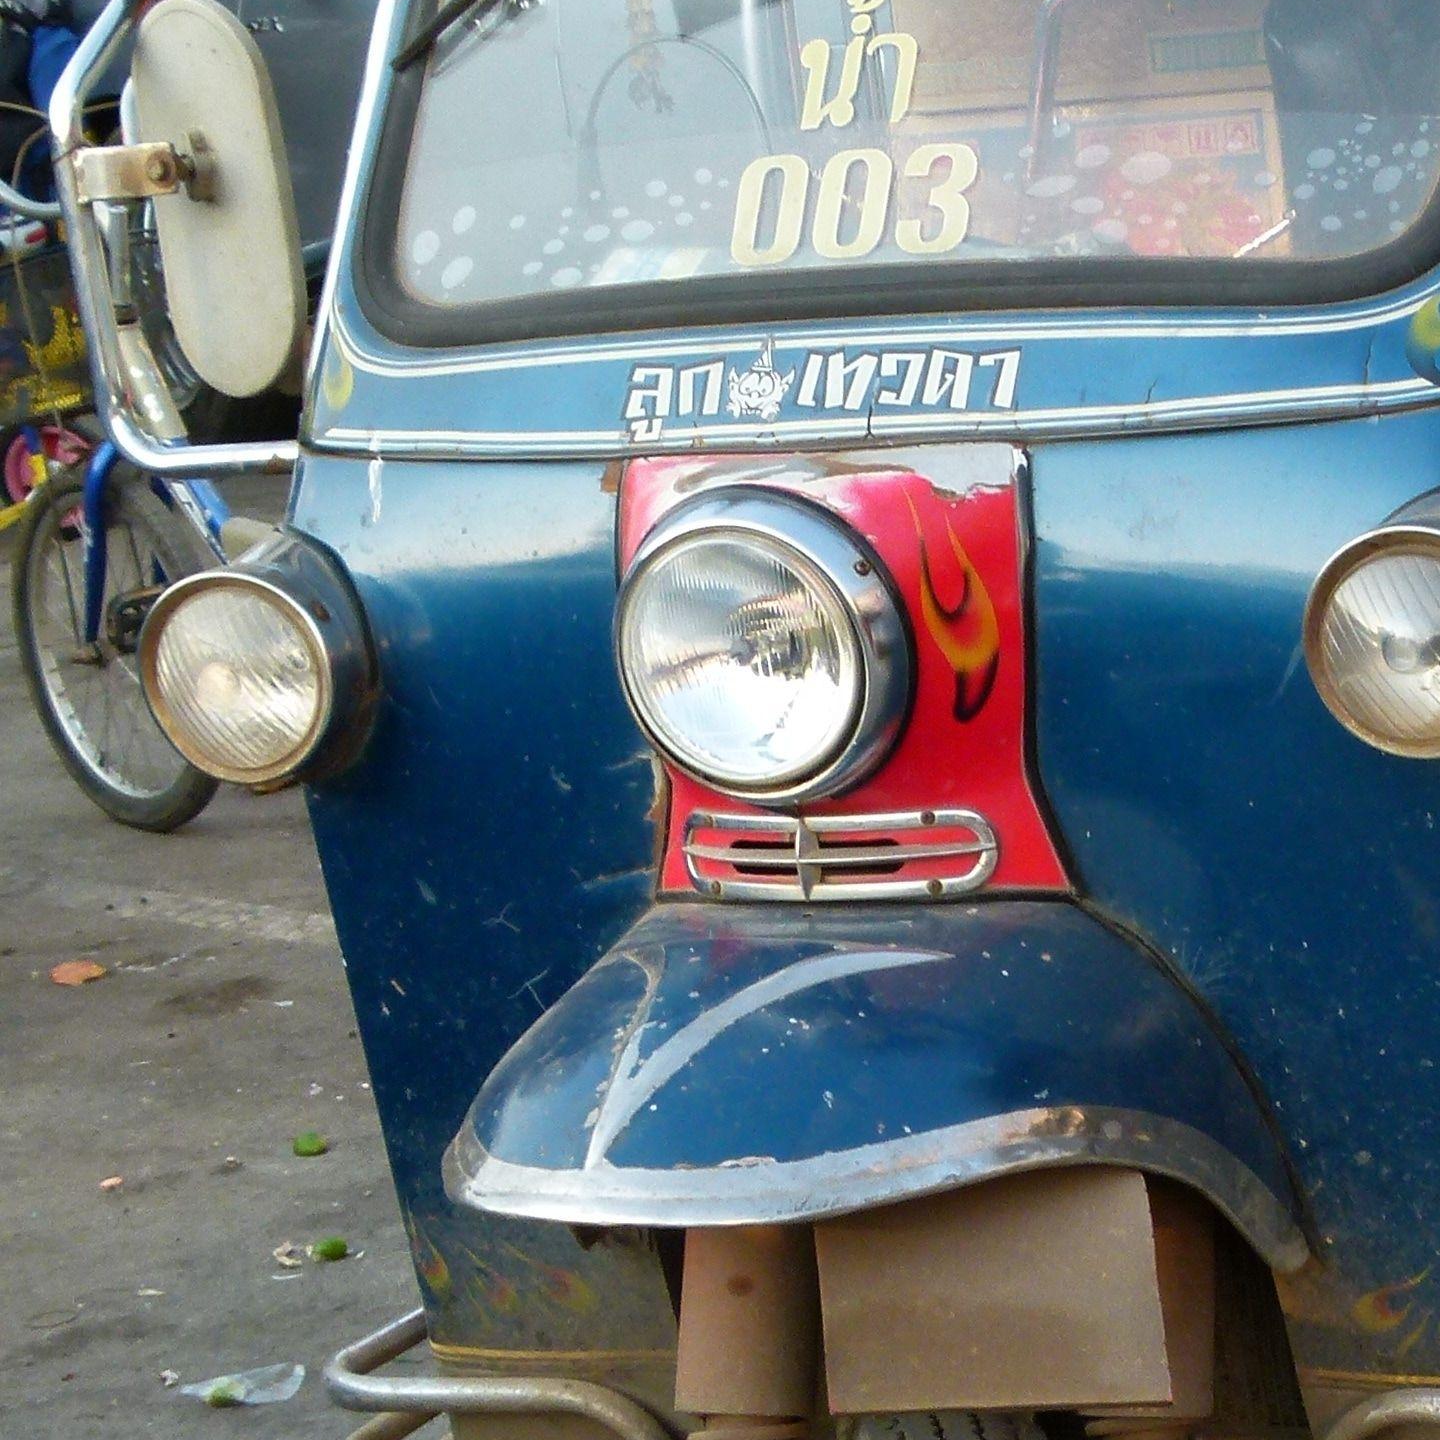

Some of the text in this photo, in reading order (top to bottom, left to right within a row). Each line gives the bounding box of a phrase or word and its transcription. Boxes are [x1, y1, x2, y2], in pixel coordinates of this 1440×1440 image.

[730, 142, 978, 266] 003
[625, 360, 727, 443] ลูก
[797, 346, 1022, 410] เทวดา
